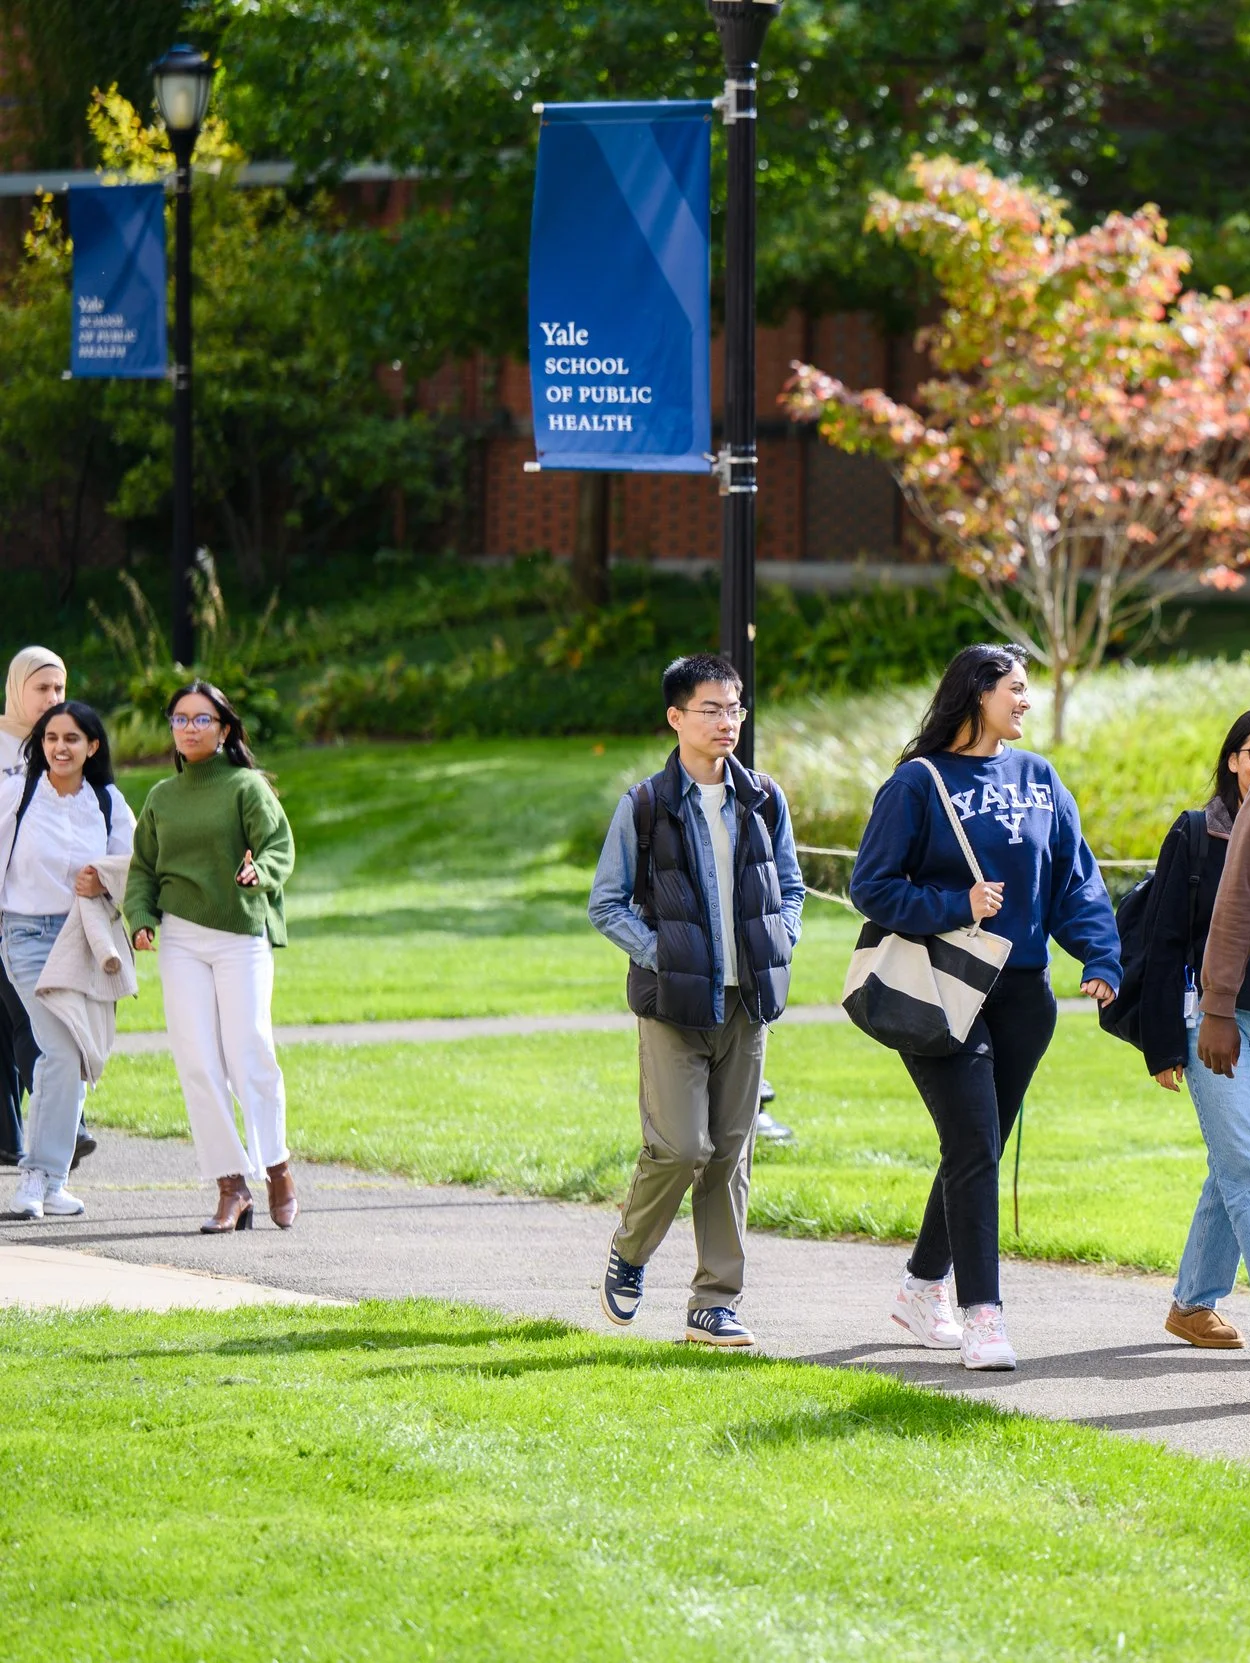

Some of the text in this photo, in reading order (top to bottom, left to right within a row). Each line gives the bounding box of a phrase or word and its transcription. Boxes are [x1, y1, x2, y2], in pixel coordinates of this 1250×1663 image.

[540, 321, 589, 346] Yale
[544, 357, 630, 375] SCHOOL
[545, 385, 653, 404] OF PUBLIC
[548, 413, 634, 432] HEALTH
[950, 781, 1054, 821] YALE
[994, 812, 1025, 845] Y
